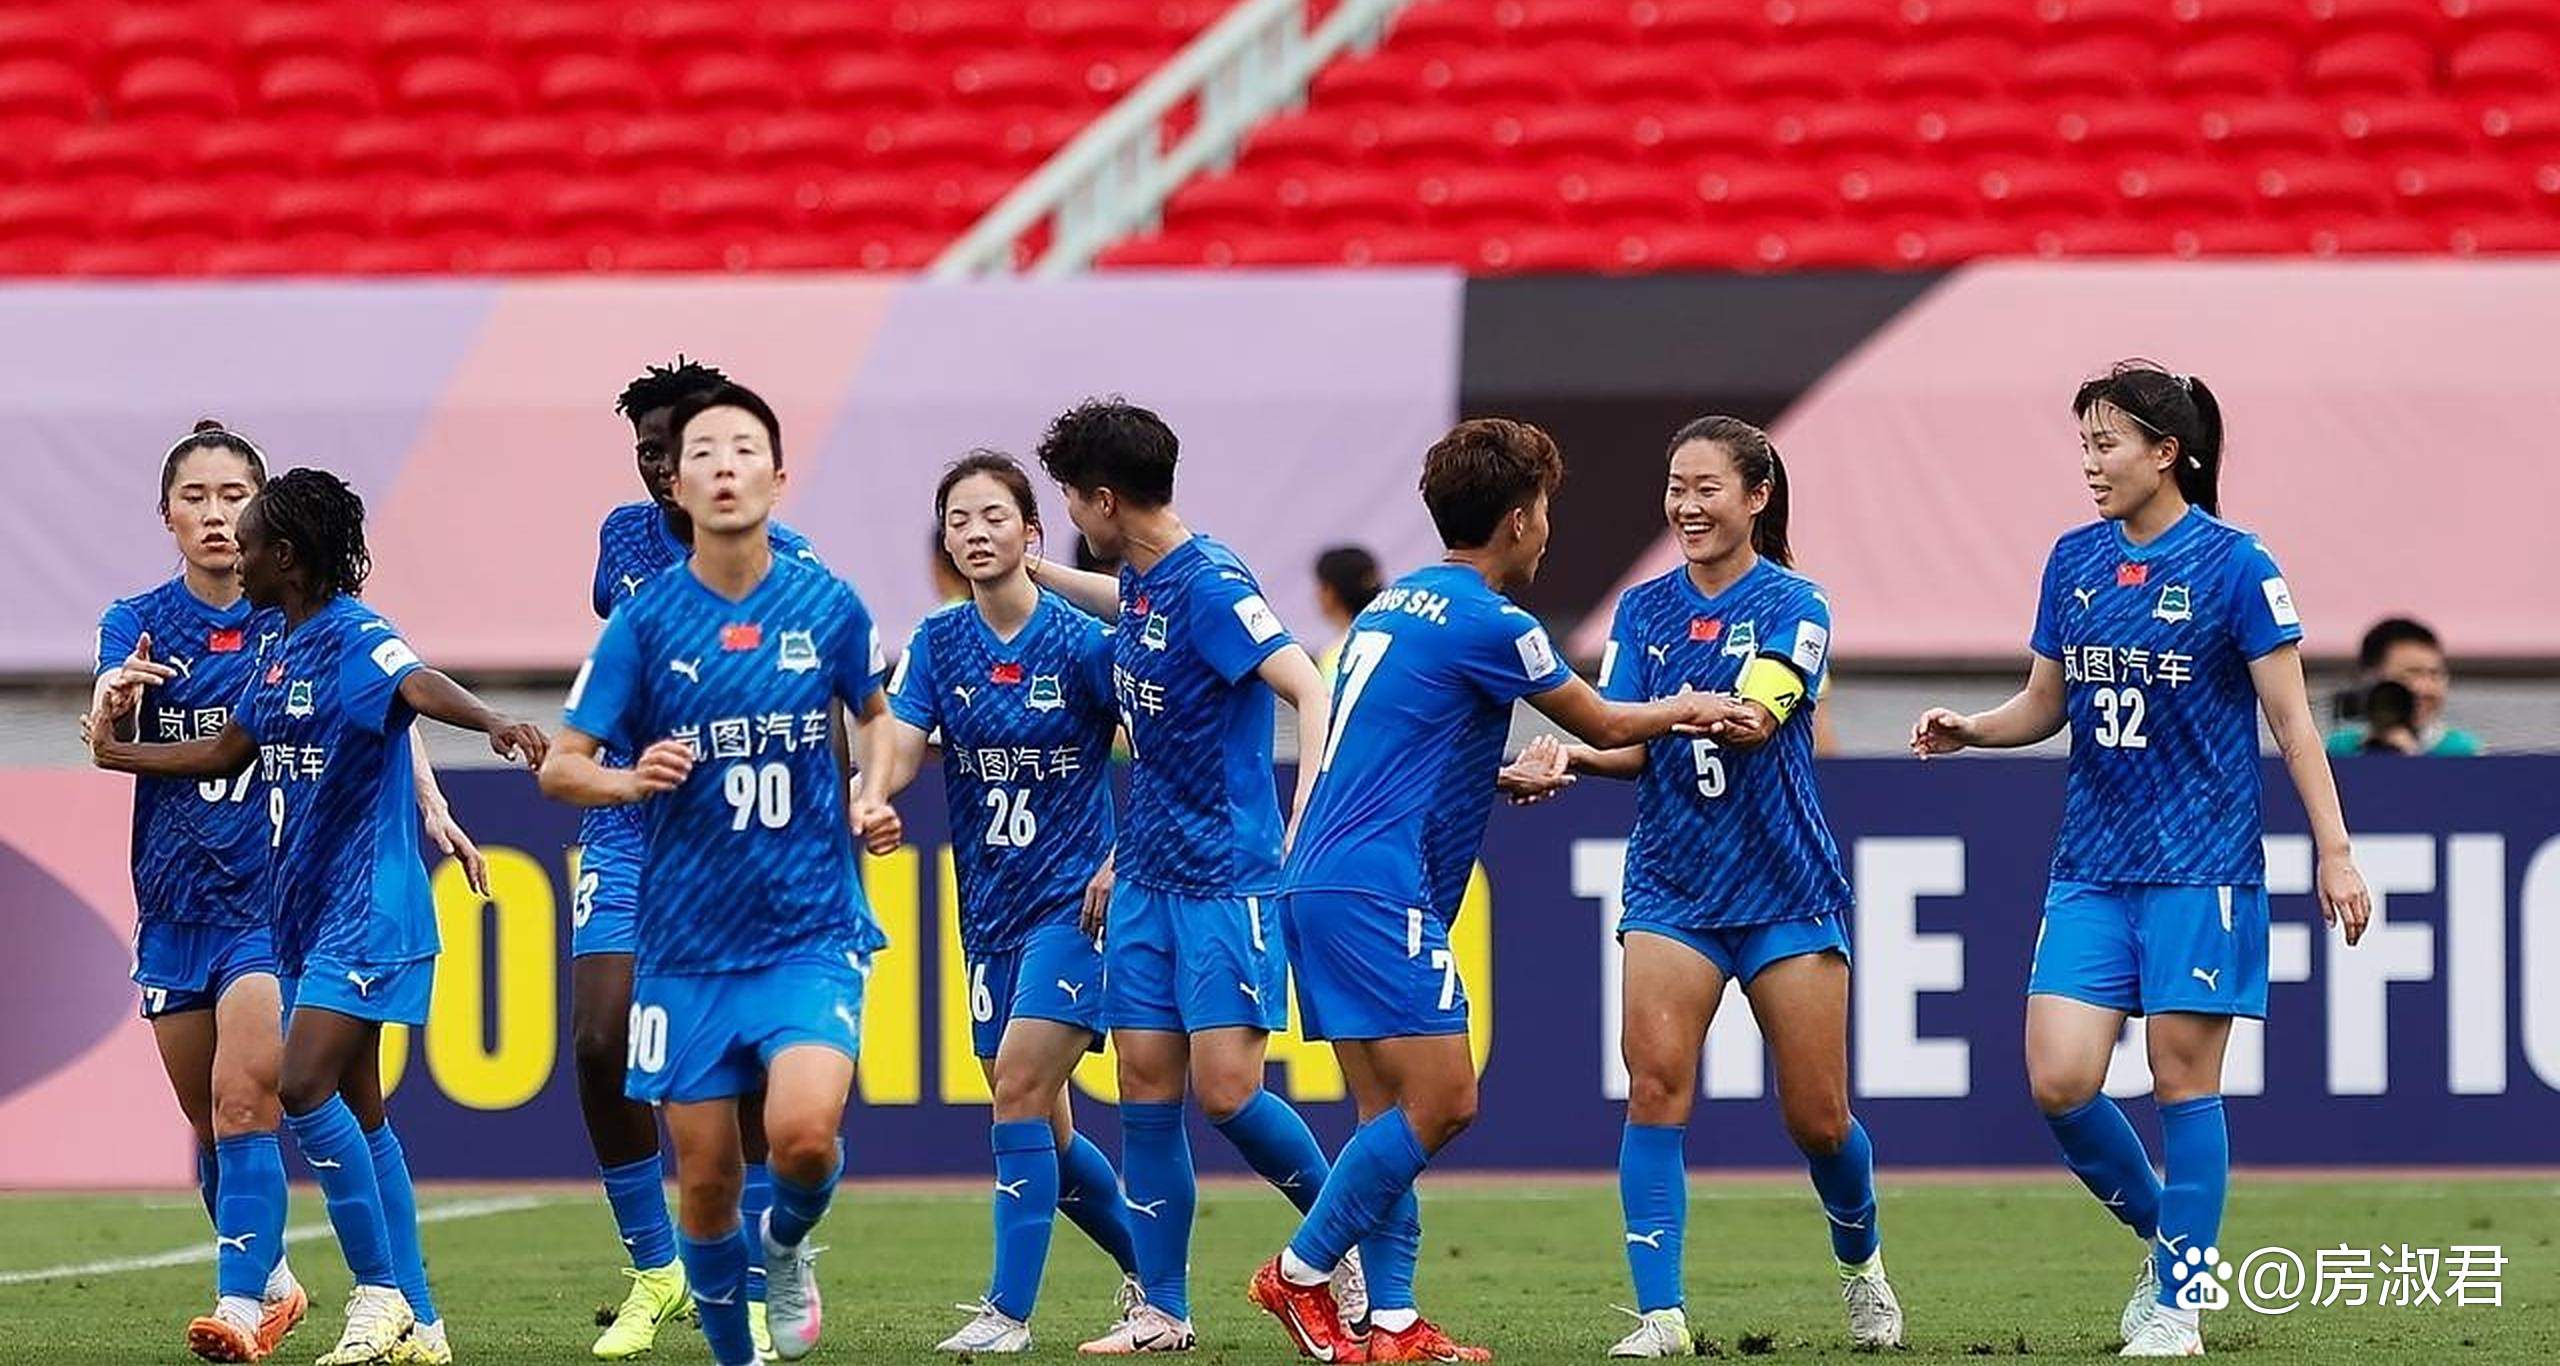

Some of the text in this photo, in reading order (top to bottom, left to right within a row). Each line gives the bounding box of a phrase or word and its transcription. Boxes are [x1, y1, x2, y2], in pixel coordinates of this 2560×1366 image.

[1403, 589, 1450, 625] SH.
[2062, 644, 2193, 688] 岚图汽车
[1322, 631, 1393, 773] 7
[2093, 687, 2147, 748] 32
[724, 763, 792, 831] 90
[1691, 738, 1726, 798] 5
[269, 787, 285, 847] 9
[986, 787, 1037, 847] 26
[1431, 949, 1456, 1010] 7
[627, 1001, 669, 1074] 90
